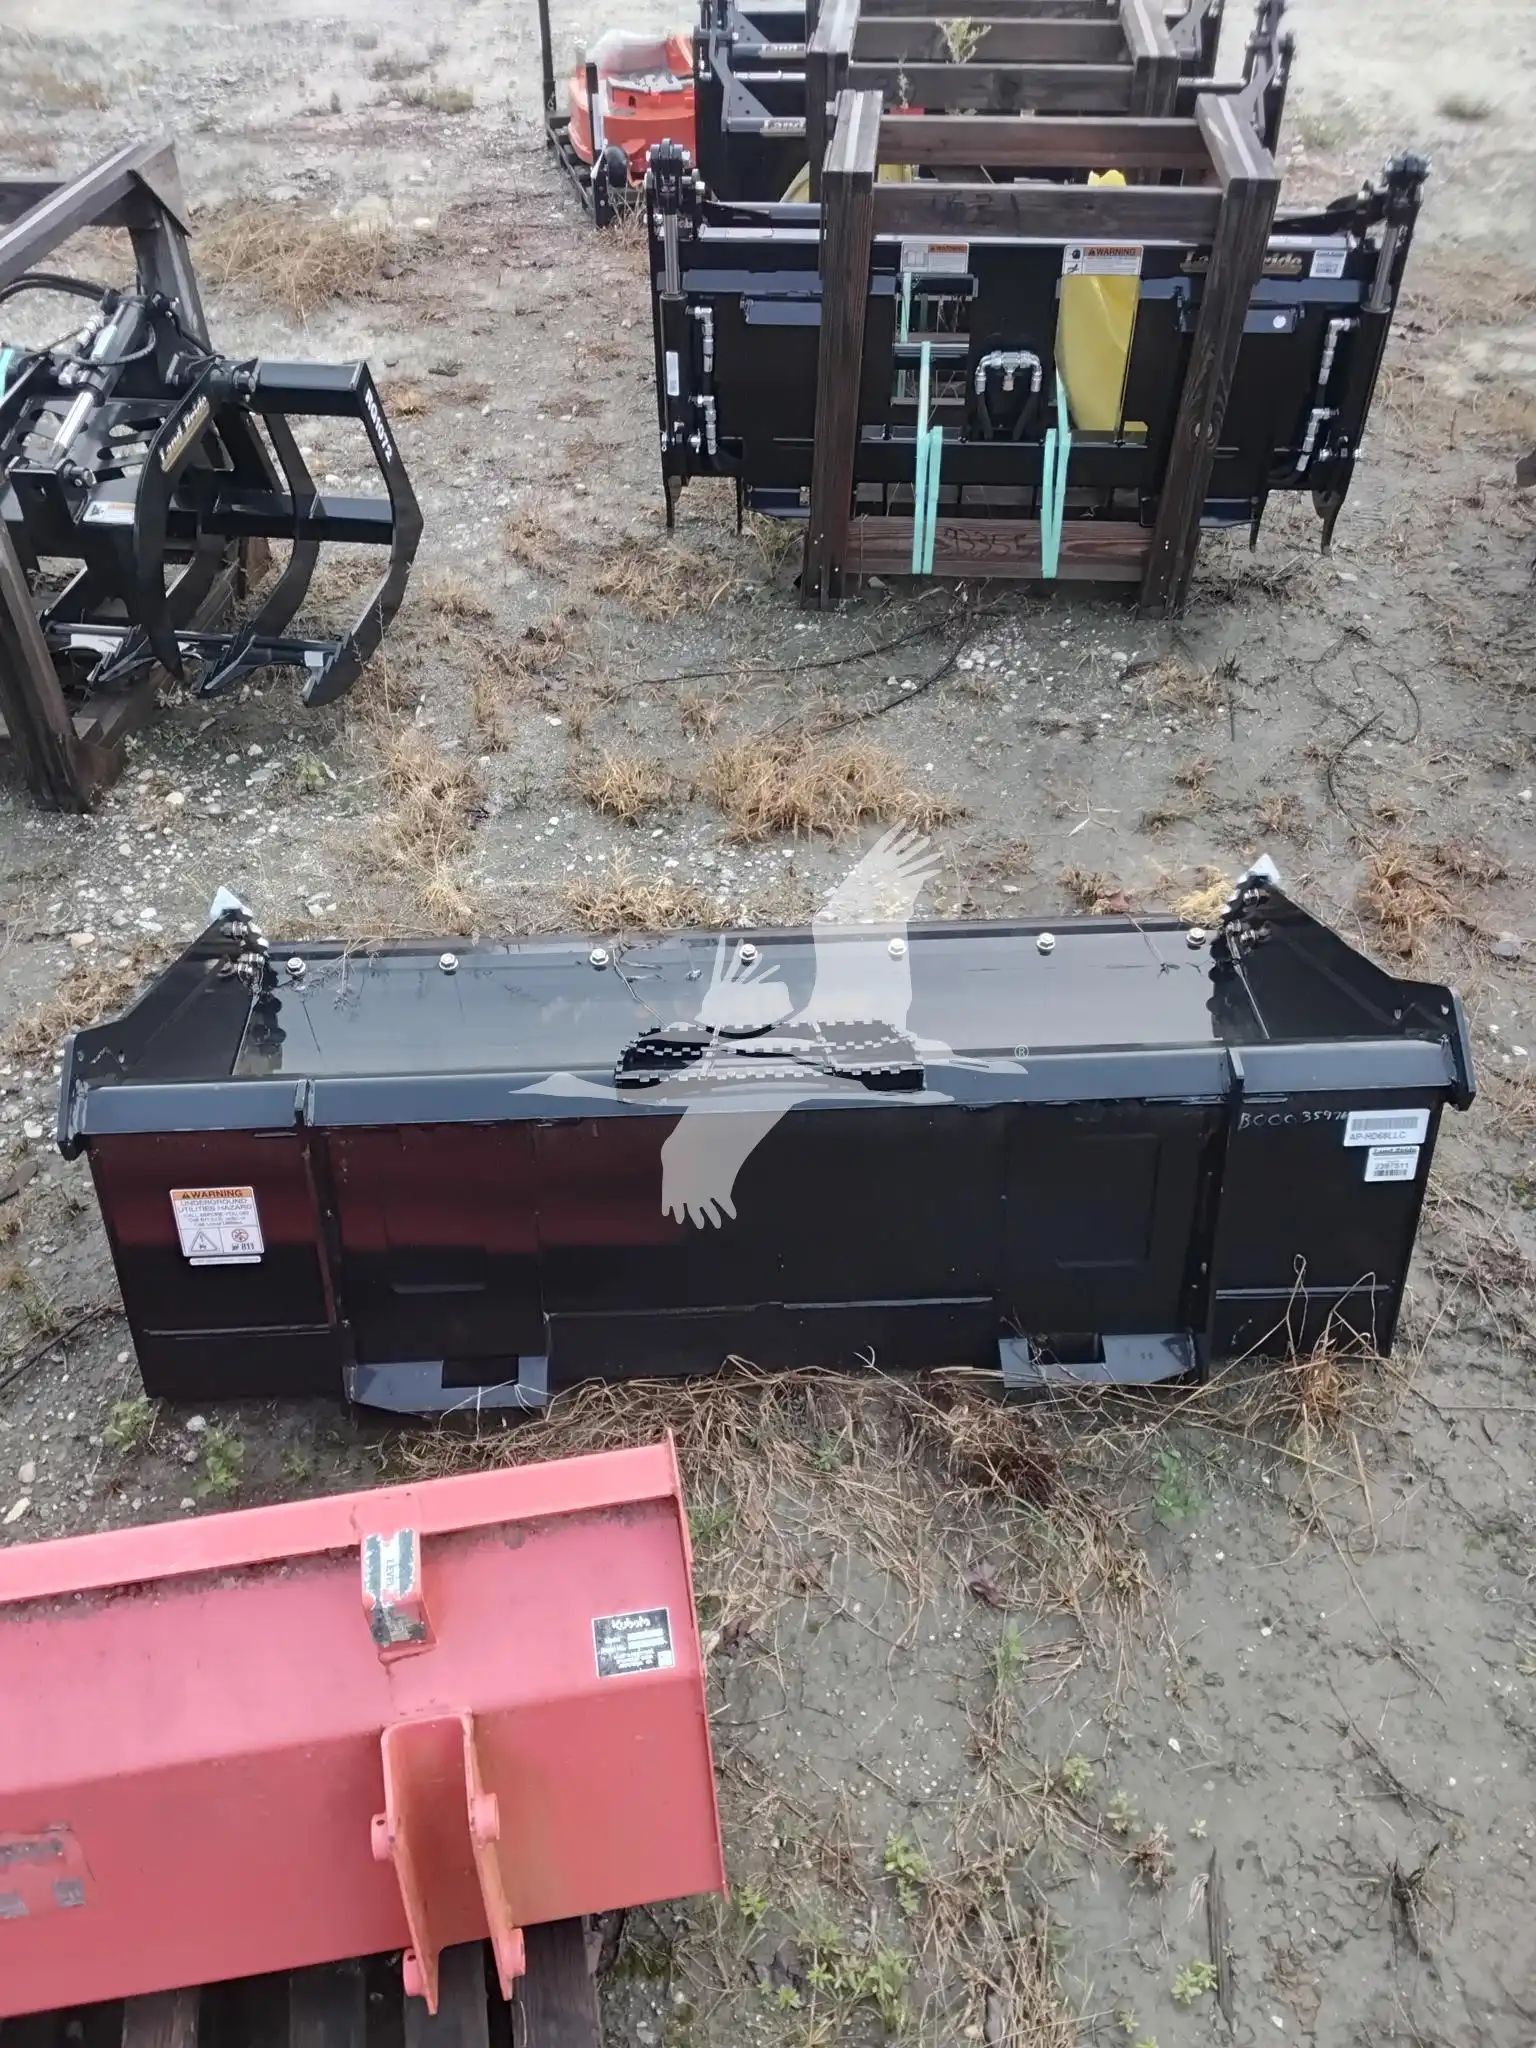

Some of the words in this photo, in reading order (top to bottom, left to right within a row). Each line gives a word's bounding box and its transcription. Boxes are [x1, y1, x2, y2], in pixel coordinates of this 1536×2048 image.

[192, 1189, 243, 1199] WARNING
[181, 1199, 247, 1207] UNDERGROUND
[217, 1203, 253, 1211] HAZARD
[611, 1616, 651, 1630] Kubota
